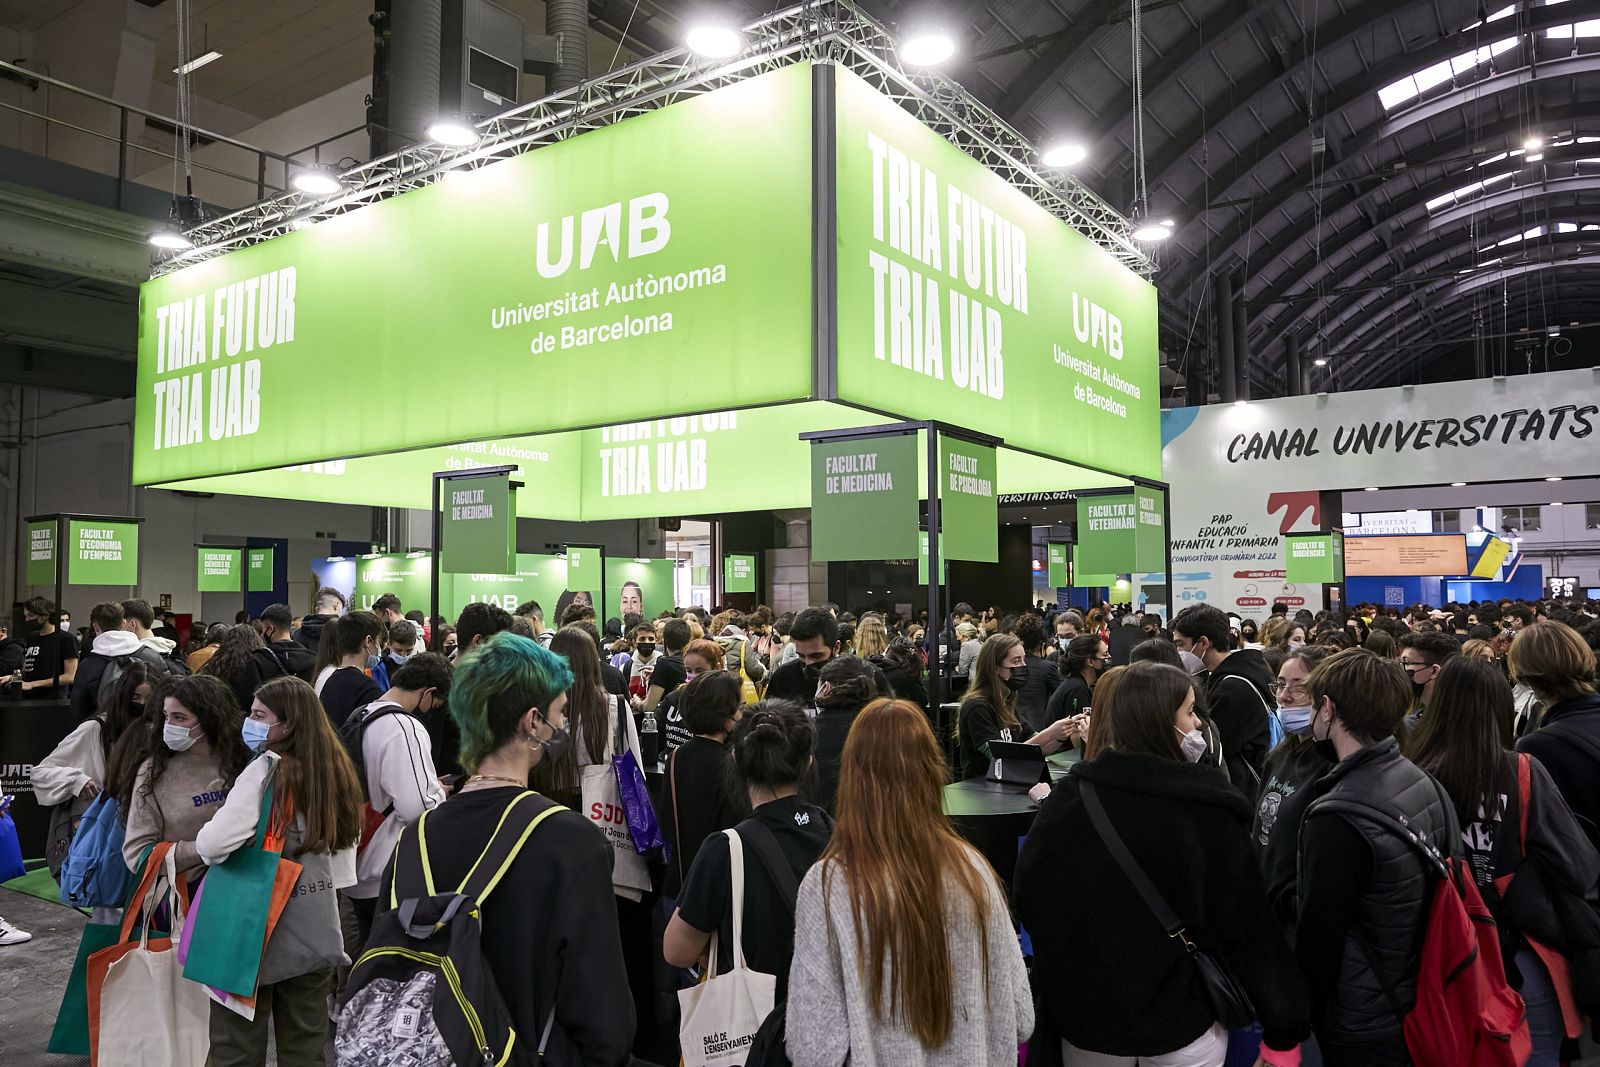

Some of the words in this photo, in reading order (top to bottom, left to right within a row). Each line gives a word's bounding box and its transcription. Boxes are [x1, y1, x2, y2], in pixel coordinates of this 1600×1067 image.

[868, 131, 942, 272] TRIA
[948, 183, 1029, 315] FUTUR
[536, 191, 672, 279] UAB
[490, 285, 600, 330] Universitat
[605, 263, 726, 307] Autònoma
[156, 290, 205, 375] TRIA
[212, 265, 298, 361] FUTUR
[869, 250, 944, 381] TRIA
[950, 288, 1004, 400] UAB
[1072, 291, 1124, 361] UAB
[530, 331, 555, 356] de
[561, 309, 674, 350] Barcelona
[1053, 343, 1101, 382] Universitat
[1102, 362, 1141, 400] Autònoma
[153, 363, 203, 451] TRIA
[210, 358, 262, 438] UAB
[1073, 381, 1085, 403] de
[1086, 385, 1127, 419] Barcelona
[1228, 427, 1319, 463] CANAL
[1333, 404, 1599, 456] UNIVERSITATS
[490, 442, 549, 462] Autònoma
[949, 452, 978, 474] FACULTAT
[600, 444, 651, 497] TRIA
[657, 438, 707, 493] UAB
[826, 452, 878, 475] FACULTAT
[826, 476, 839, 495] DE
[841, 472, 893, 494] MEDICINA
[949, 473, 958, 491] DE
[958, 475, 992, 498] PSICOLOGIA
[452, 489, 485, 505] FACULTAT
[452, 506, 461, 520] DE
[461, 504, 493, 520] MEDICINA
[1088, 504, 1128, 518] FACULTAT
[1211, 514, 1233, 525] PAP
[1088, 515, 1136, 531] VETERINÀRI
[1198, 523, 1248, 538] EDUCACIÓ
[1349, 526, 1418, 535] BARCELONA
[79, 539, 122, 551] D'ECONOMIA
[80, 529, 114, 540] FACULTAT
[1218, 539, 1223, 548] I
[1226, 534, 1279, 548] PRIMÀRIA
[1292, 541, 1318, 550] FACULTAT
[83, 550, 122, 561] D'EMPRESA
[1220, 551, 1256, 562] ORDINÀRIA
[1257, 552, 1277, 561] 2022
[591, 802, 624, 825] SJD
[608, 827, 625, 839] Joan
[703, 1032, 719, 1046] SALÓ
[719, 1032, 728, 1042] DE
